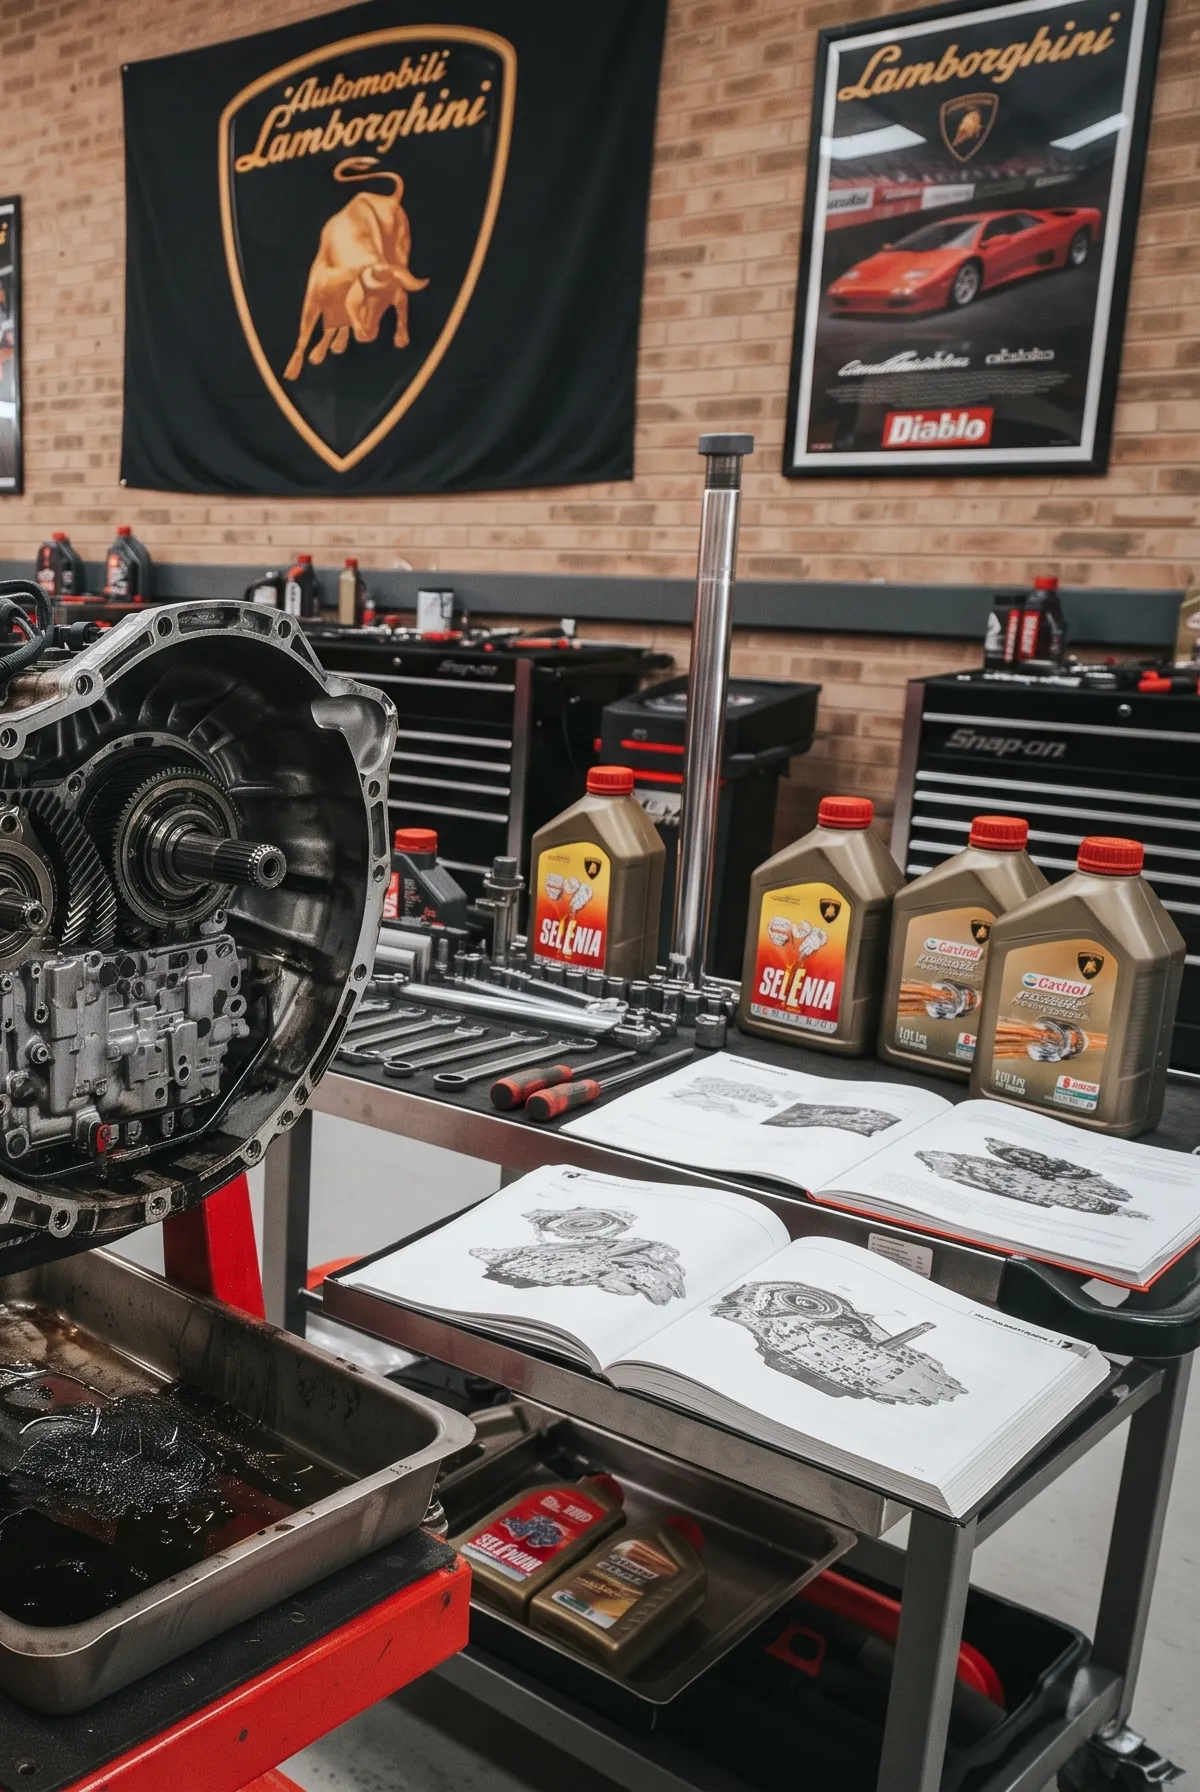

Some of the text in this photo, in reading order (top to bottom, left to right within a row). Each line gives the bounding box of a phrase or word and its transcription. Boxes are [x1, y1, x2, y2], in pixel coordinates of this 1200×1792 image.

[837, 11, 1121, 101] Lamborghini
[284, 50, 450, 113] Automobili
[235, 80, 491, 173] Lamborghini
[888, 412, 986, 445] Diablo
[945, 729, 1067, 758] Snap-on
[540, 917, 603, 957] SELENIA
[759, 966, 836, 1011] SELENIA
